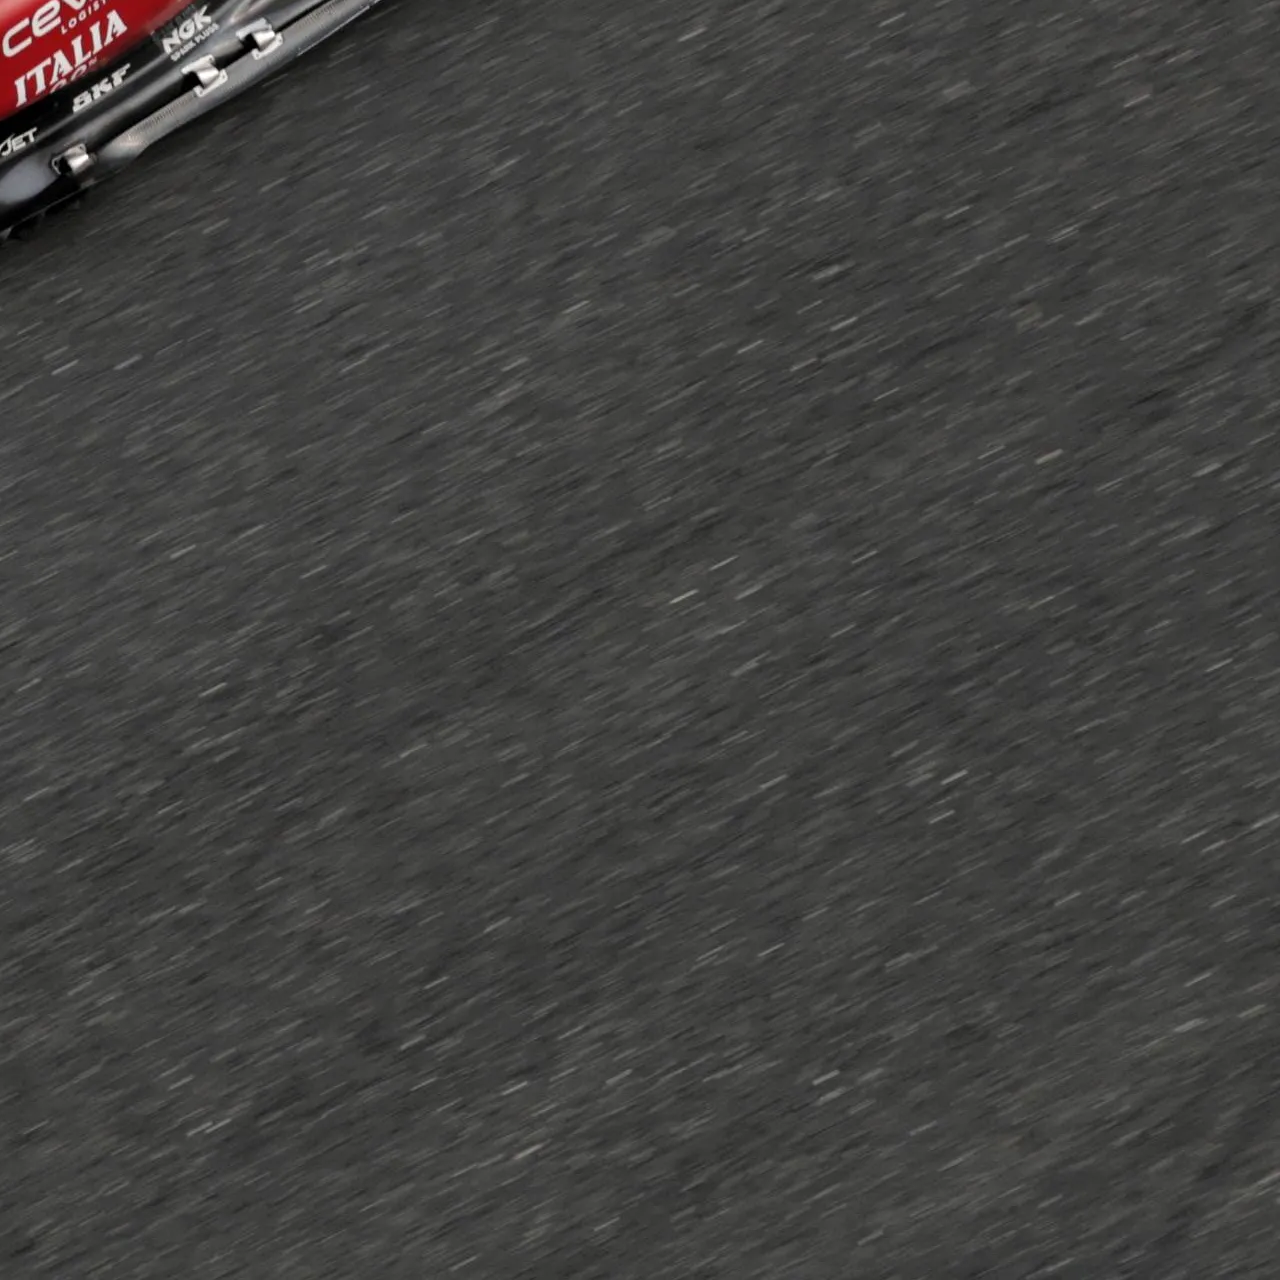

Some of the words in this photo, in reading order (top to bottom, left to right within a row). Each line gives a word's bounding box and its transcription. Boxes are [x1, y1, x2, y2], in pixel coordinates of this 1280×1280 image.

[162, 5, 212, 54] NGK
[13, 9, 128, 108] ITALIA
[72, 63, 131, 114] SKF
